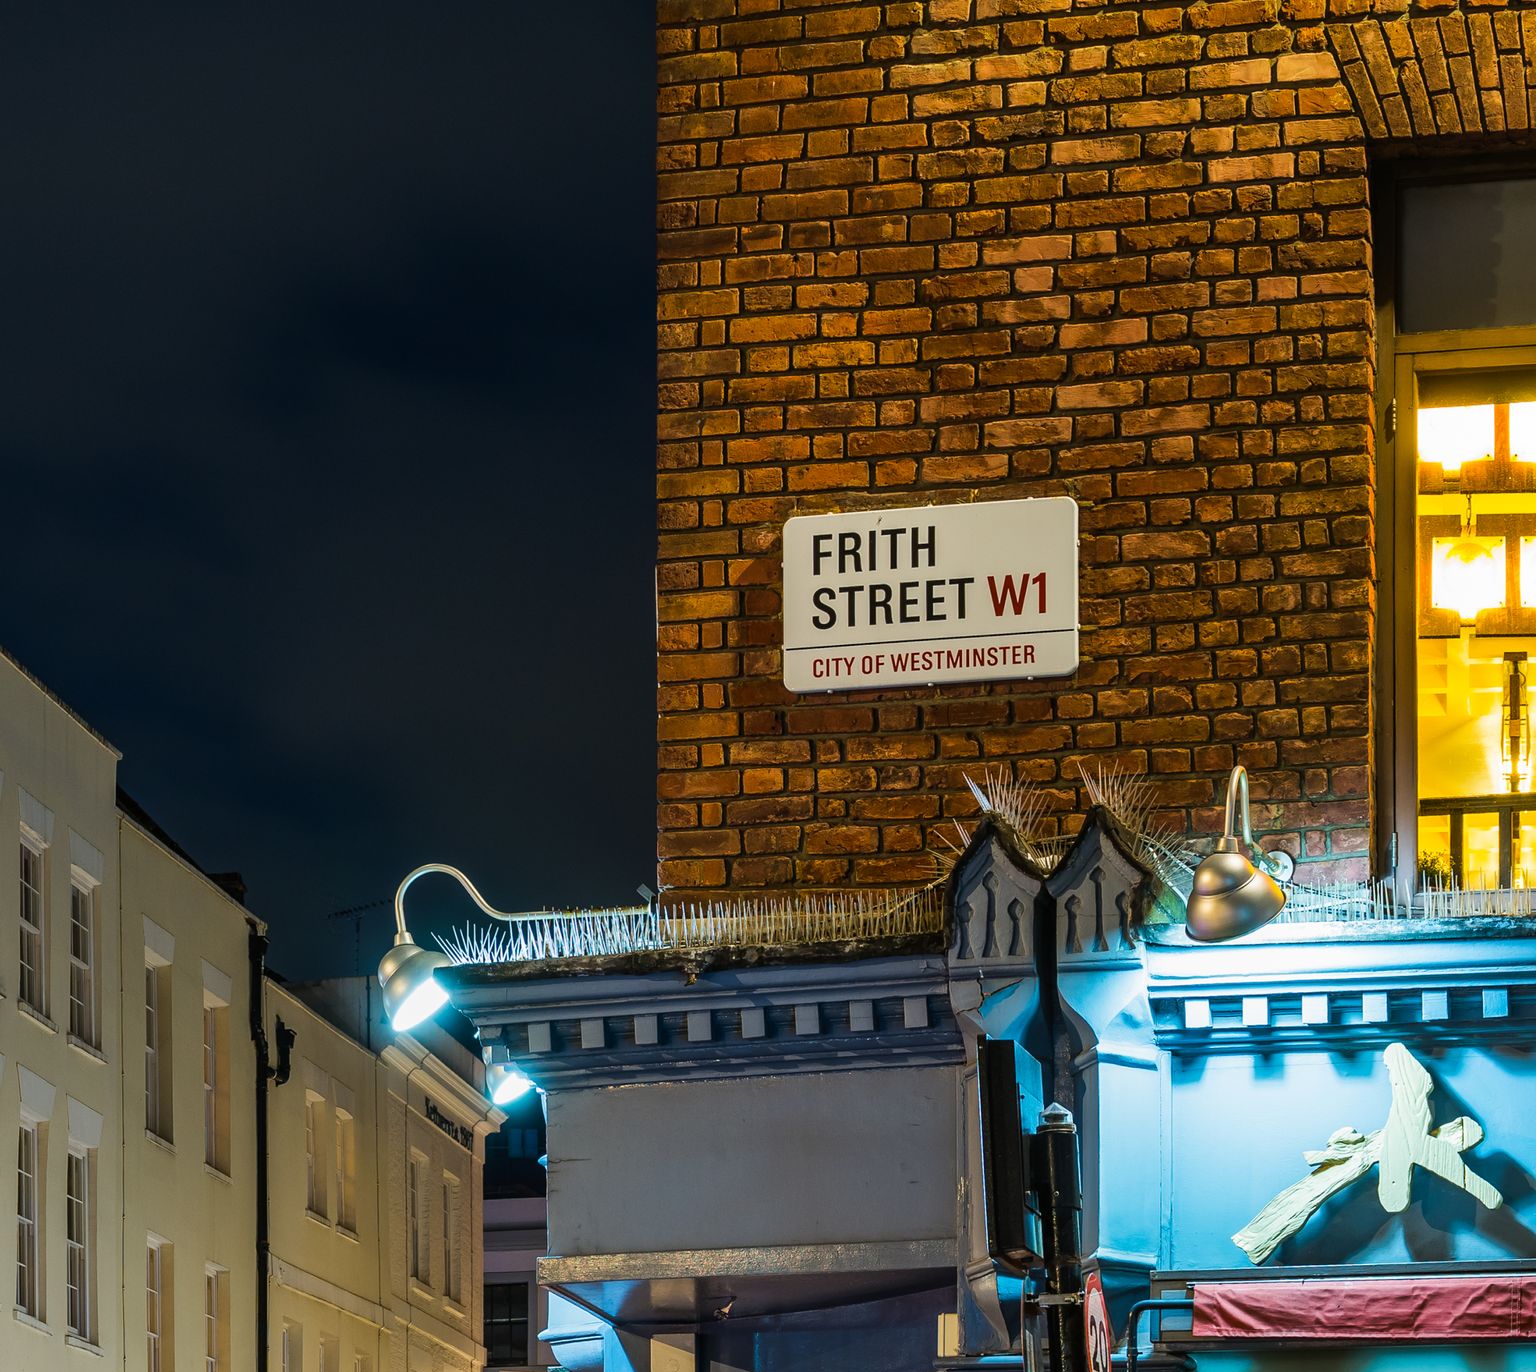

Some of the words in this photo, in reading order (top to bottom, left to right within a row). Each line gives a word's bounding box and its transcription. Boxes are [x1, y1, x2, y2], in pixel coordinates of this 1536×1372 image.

[812, 525, 936, 576] FRITH
[812, 577, 975, 630] STREET
[987, 572, 1048, 617] W1
[812, 657, 856, 679] CITY
[861, 655, 885, 675] OF
[891, 644, 1036, 673] WESTMINSTER
